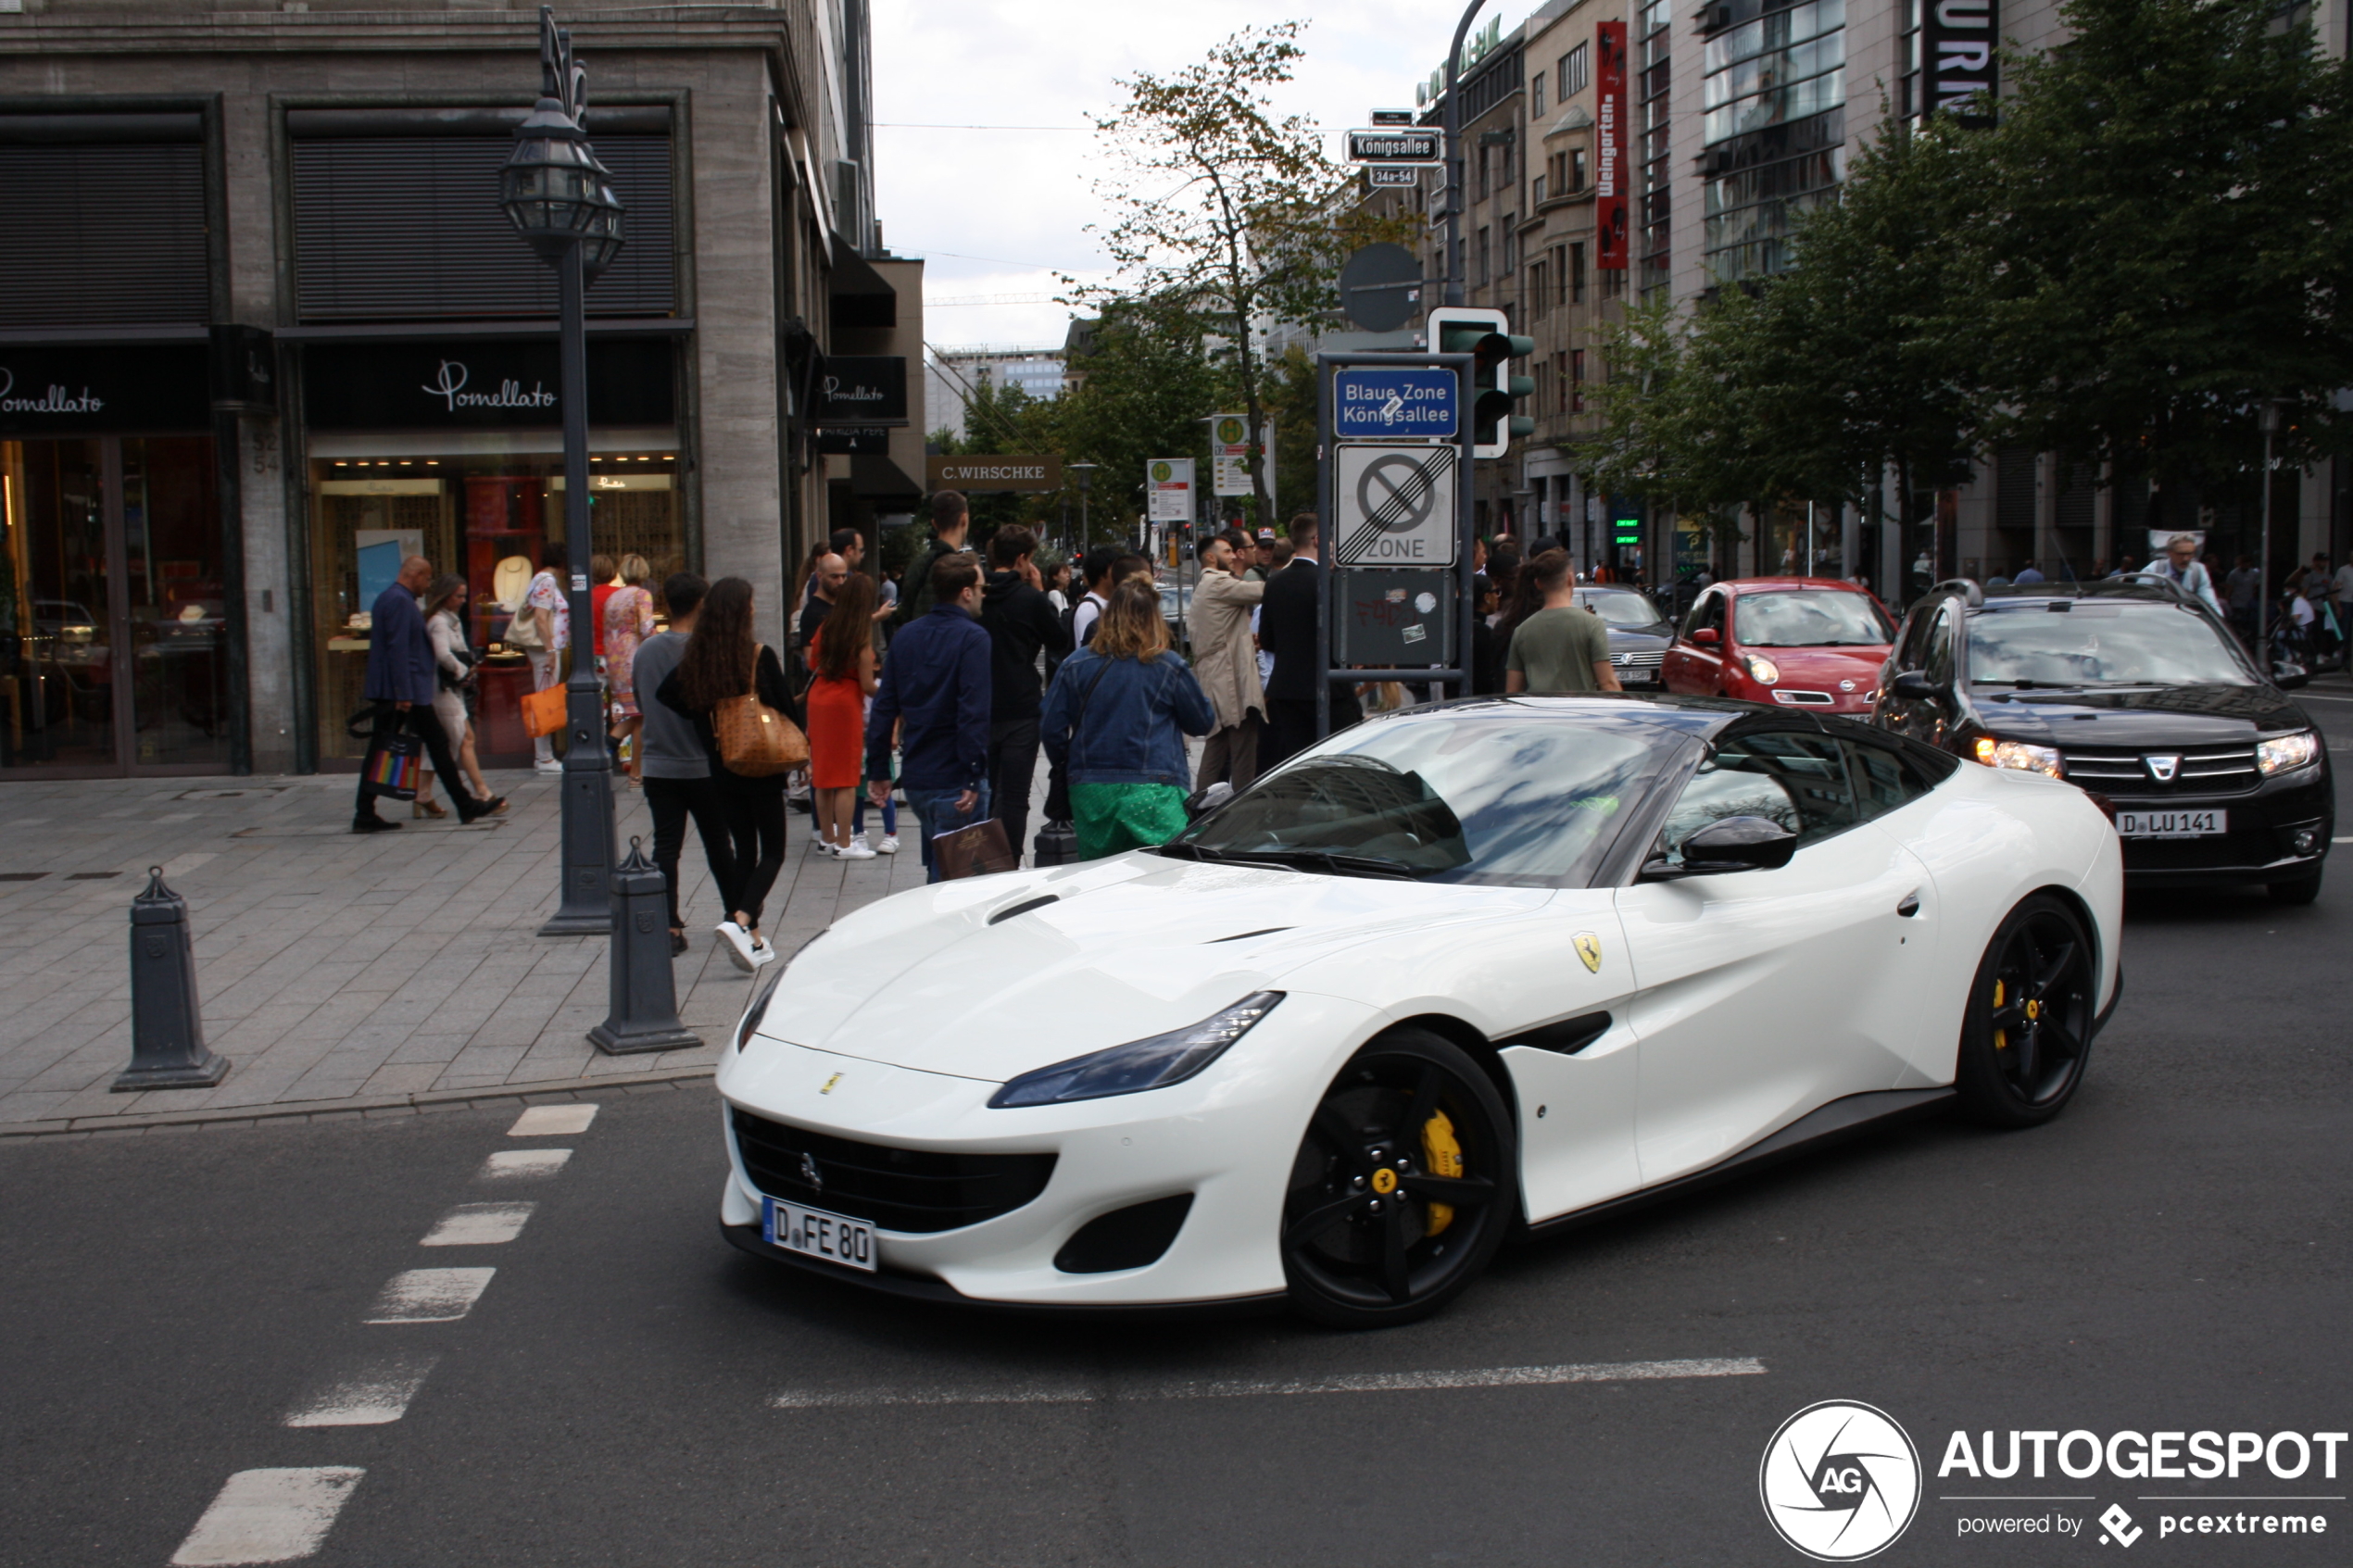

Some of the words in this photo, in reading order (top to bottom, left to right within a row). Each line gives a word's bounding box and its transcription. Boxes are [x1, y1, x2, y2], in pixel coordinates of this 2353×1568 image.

[1357, 137, 1429, 157] Königsallee
[1376, 170, 1411, 182] 34a-54
[422, 358, 558, 412] Pomellato
[823, 375, 885, 403] Pomellato
[1346, 383, 1396, 400] Blaue
[1403, 383, 1446, 400] Zone
[1343, 406, 1449, 426] Königsallee
[254, 433, 278, 452] 52
[254, 456, 278, 474] 54
[942, 466, 1045, 480] C.WIRSCHKE
[1366, 539, 1425, 558] ZONE
[2123, 815, 2135, 833] D
[776, 1206, 788, 1242] D
